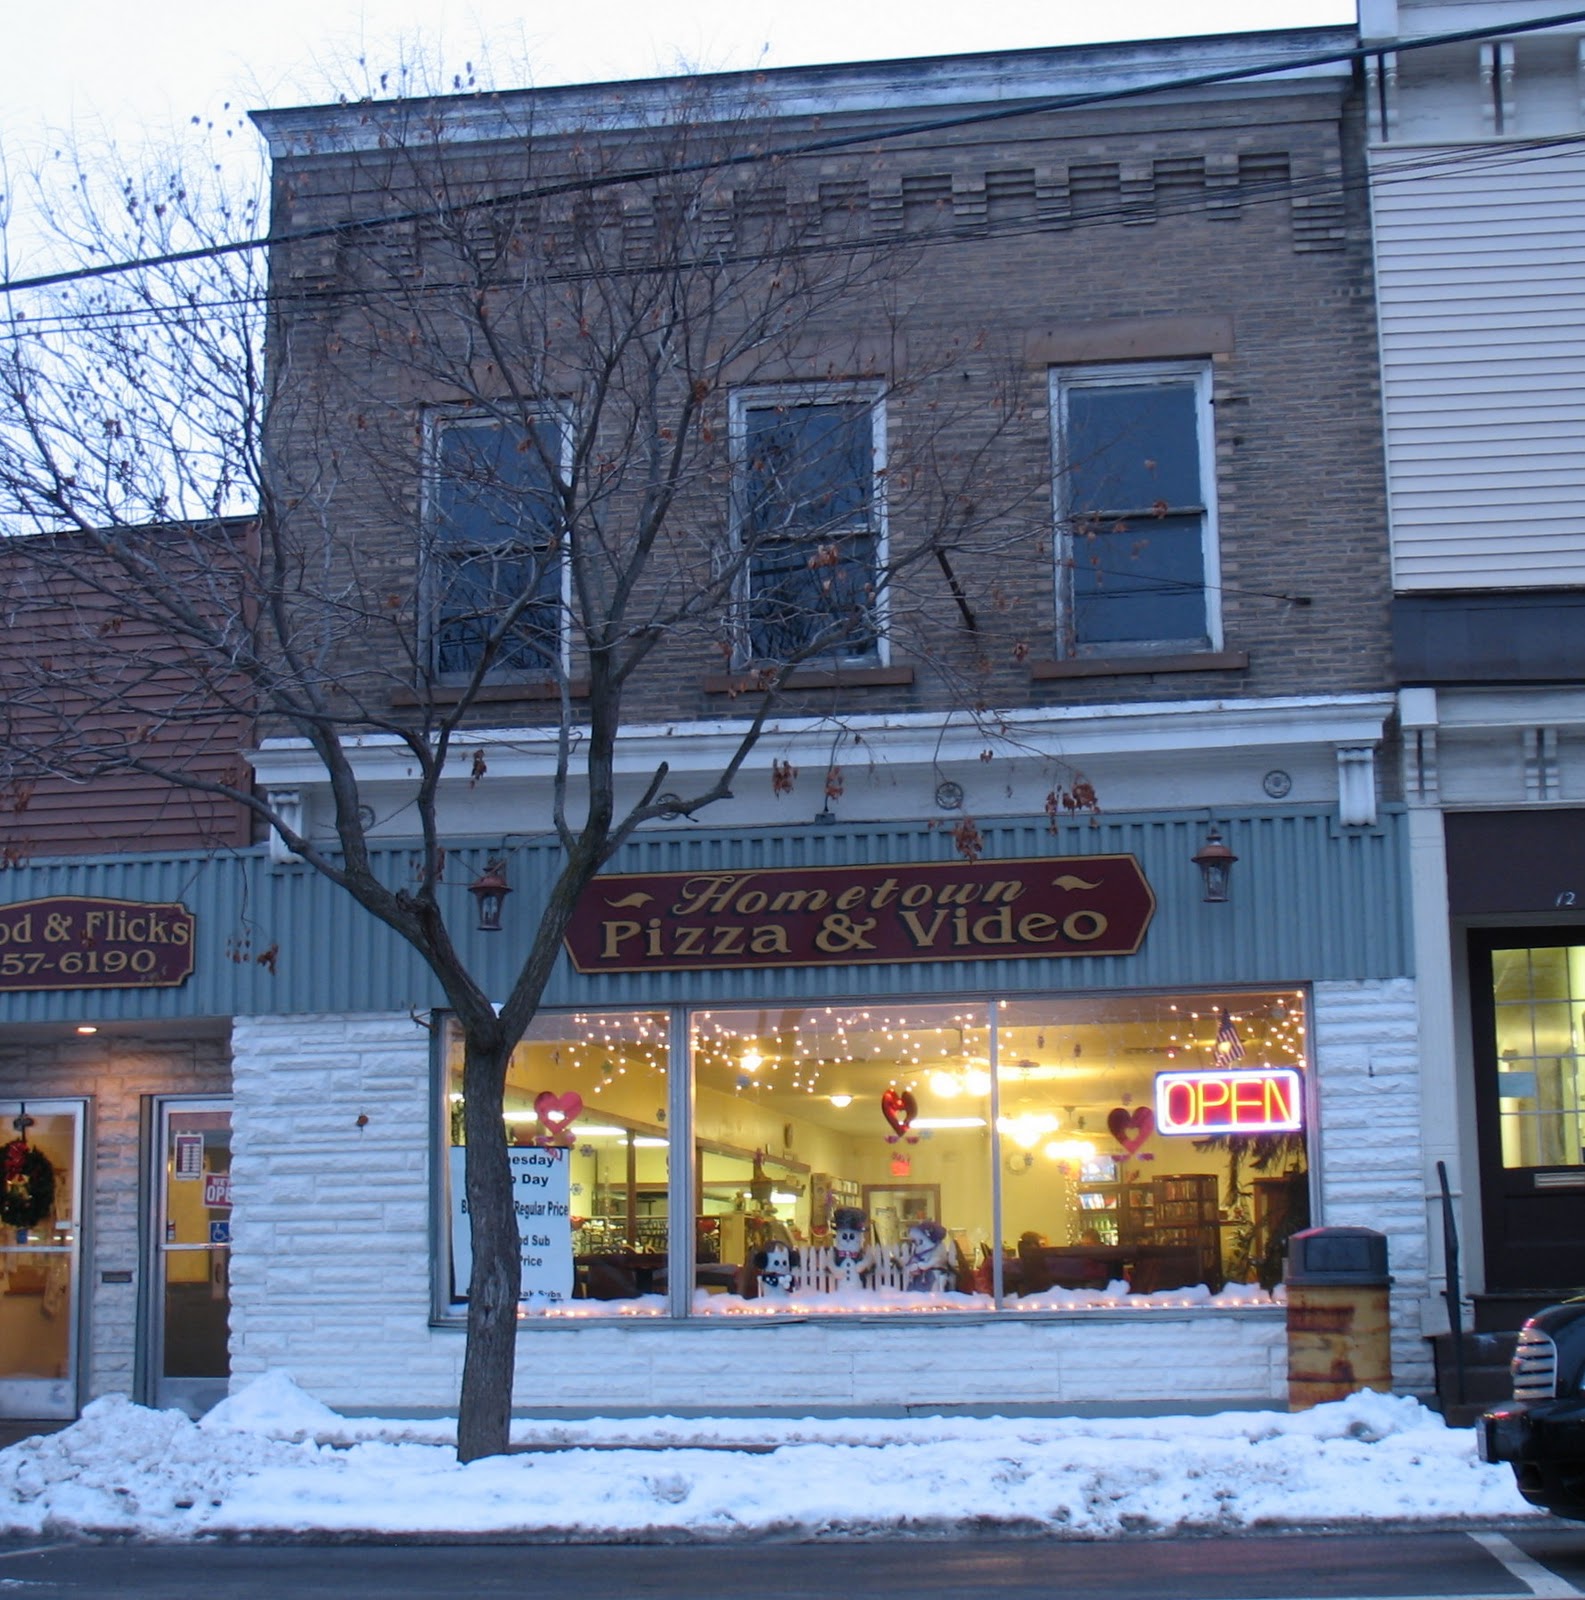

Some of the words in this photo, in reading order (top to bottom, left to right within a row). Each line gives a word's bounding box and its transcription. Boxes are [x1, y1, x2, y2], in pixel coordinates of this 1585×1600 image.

[672, 874, 1027, 915] Hometown
[1556, 891, 1576, 907] 12
[43, 912, 73, 942] &
[86, 910, 189, 945] Flicks
[600, 918, 792, 957] Pizza
[815, 913, 877, 952] &
[899, 905, 1108, 946] Video
[1, 949, 157, 975] 57-6190
[1165, 1078, 1294, 1127] OPEN
[522, 1173, 549, 1187] Day
[514, 1200, 545, 1219] Regular
[548, 1201, 568, 1216] Price
[532, 1234, 551, 1246] Sub
